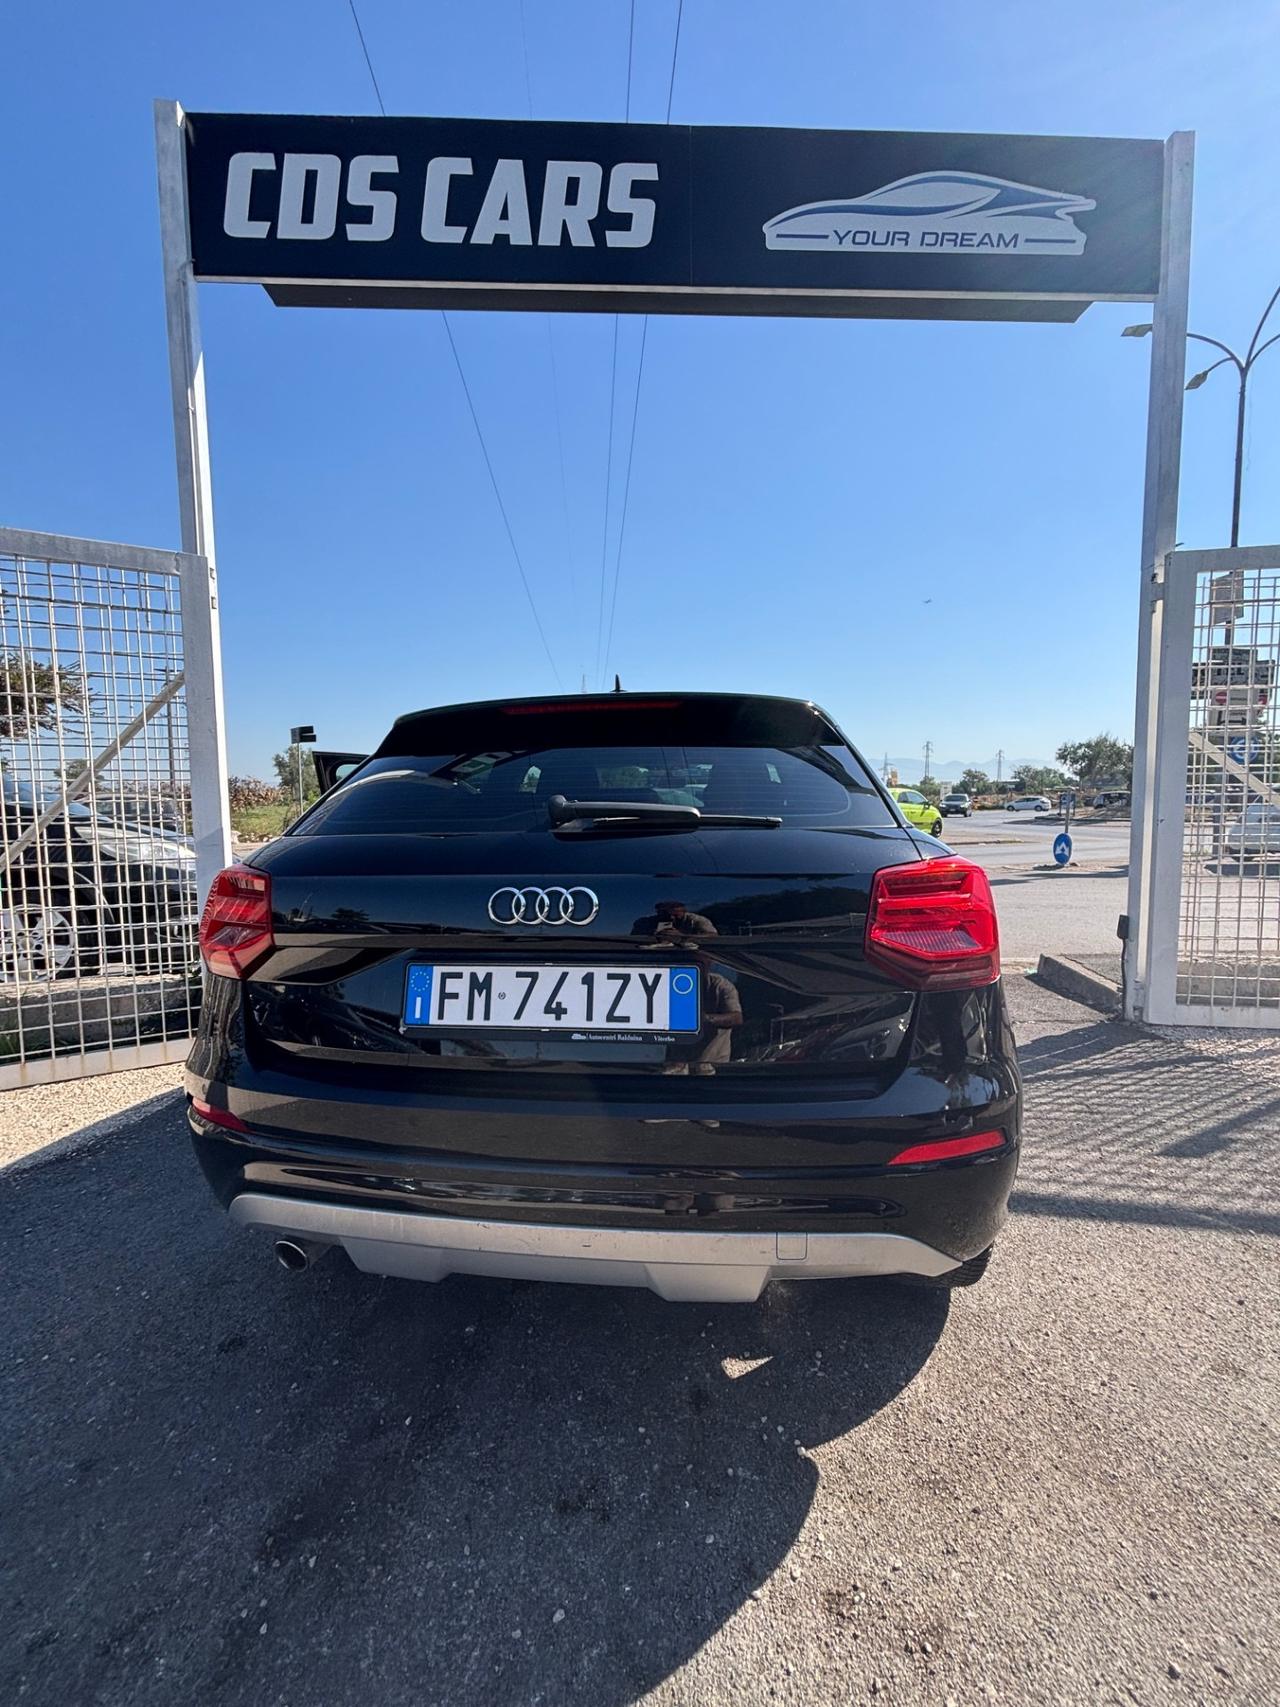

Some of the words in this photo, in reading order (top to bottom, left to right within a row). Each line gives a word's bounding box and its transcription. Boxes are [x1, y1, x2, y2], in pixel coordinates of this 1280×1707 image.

[223, 152, 399, 242] CDS
[420, 156, 659, 248] CARS
[833, 230, 910, 247] YOUR
[920, 231, 1019, 249] DREAM
